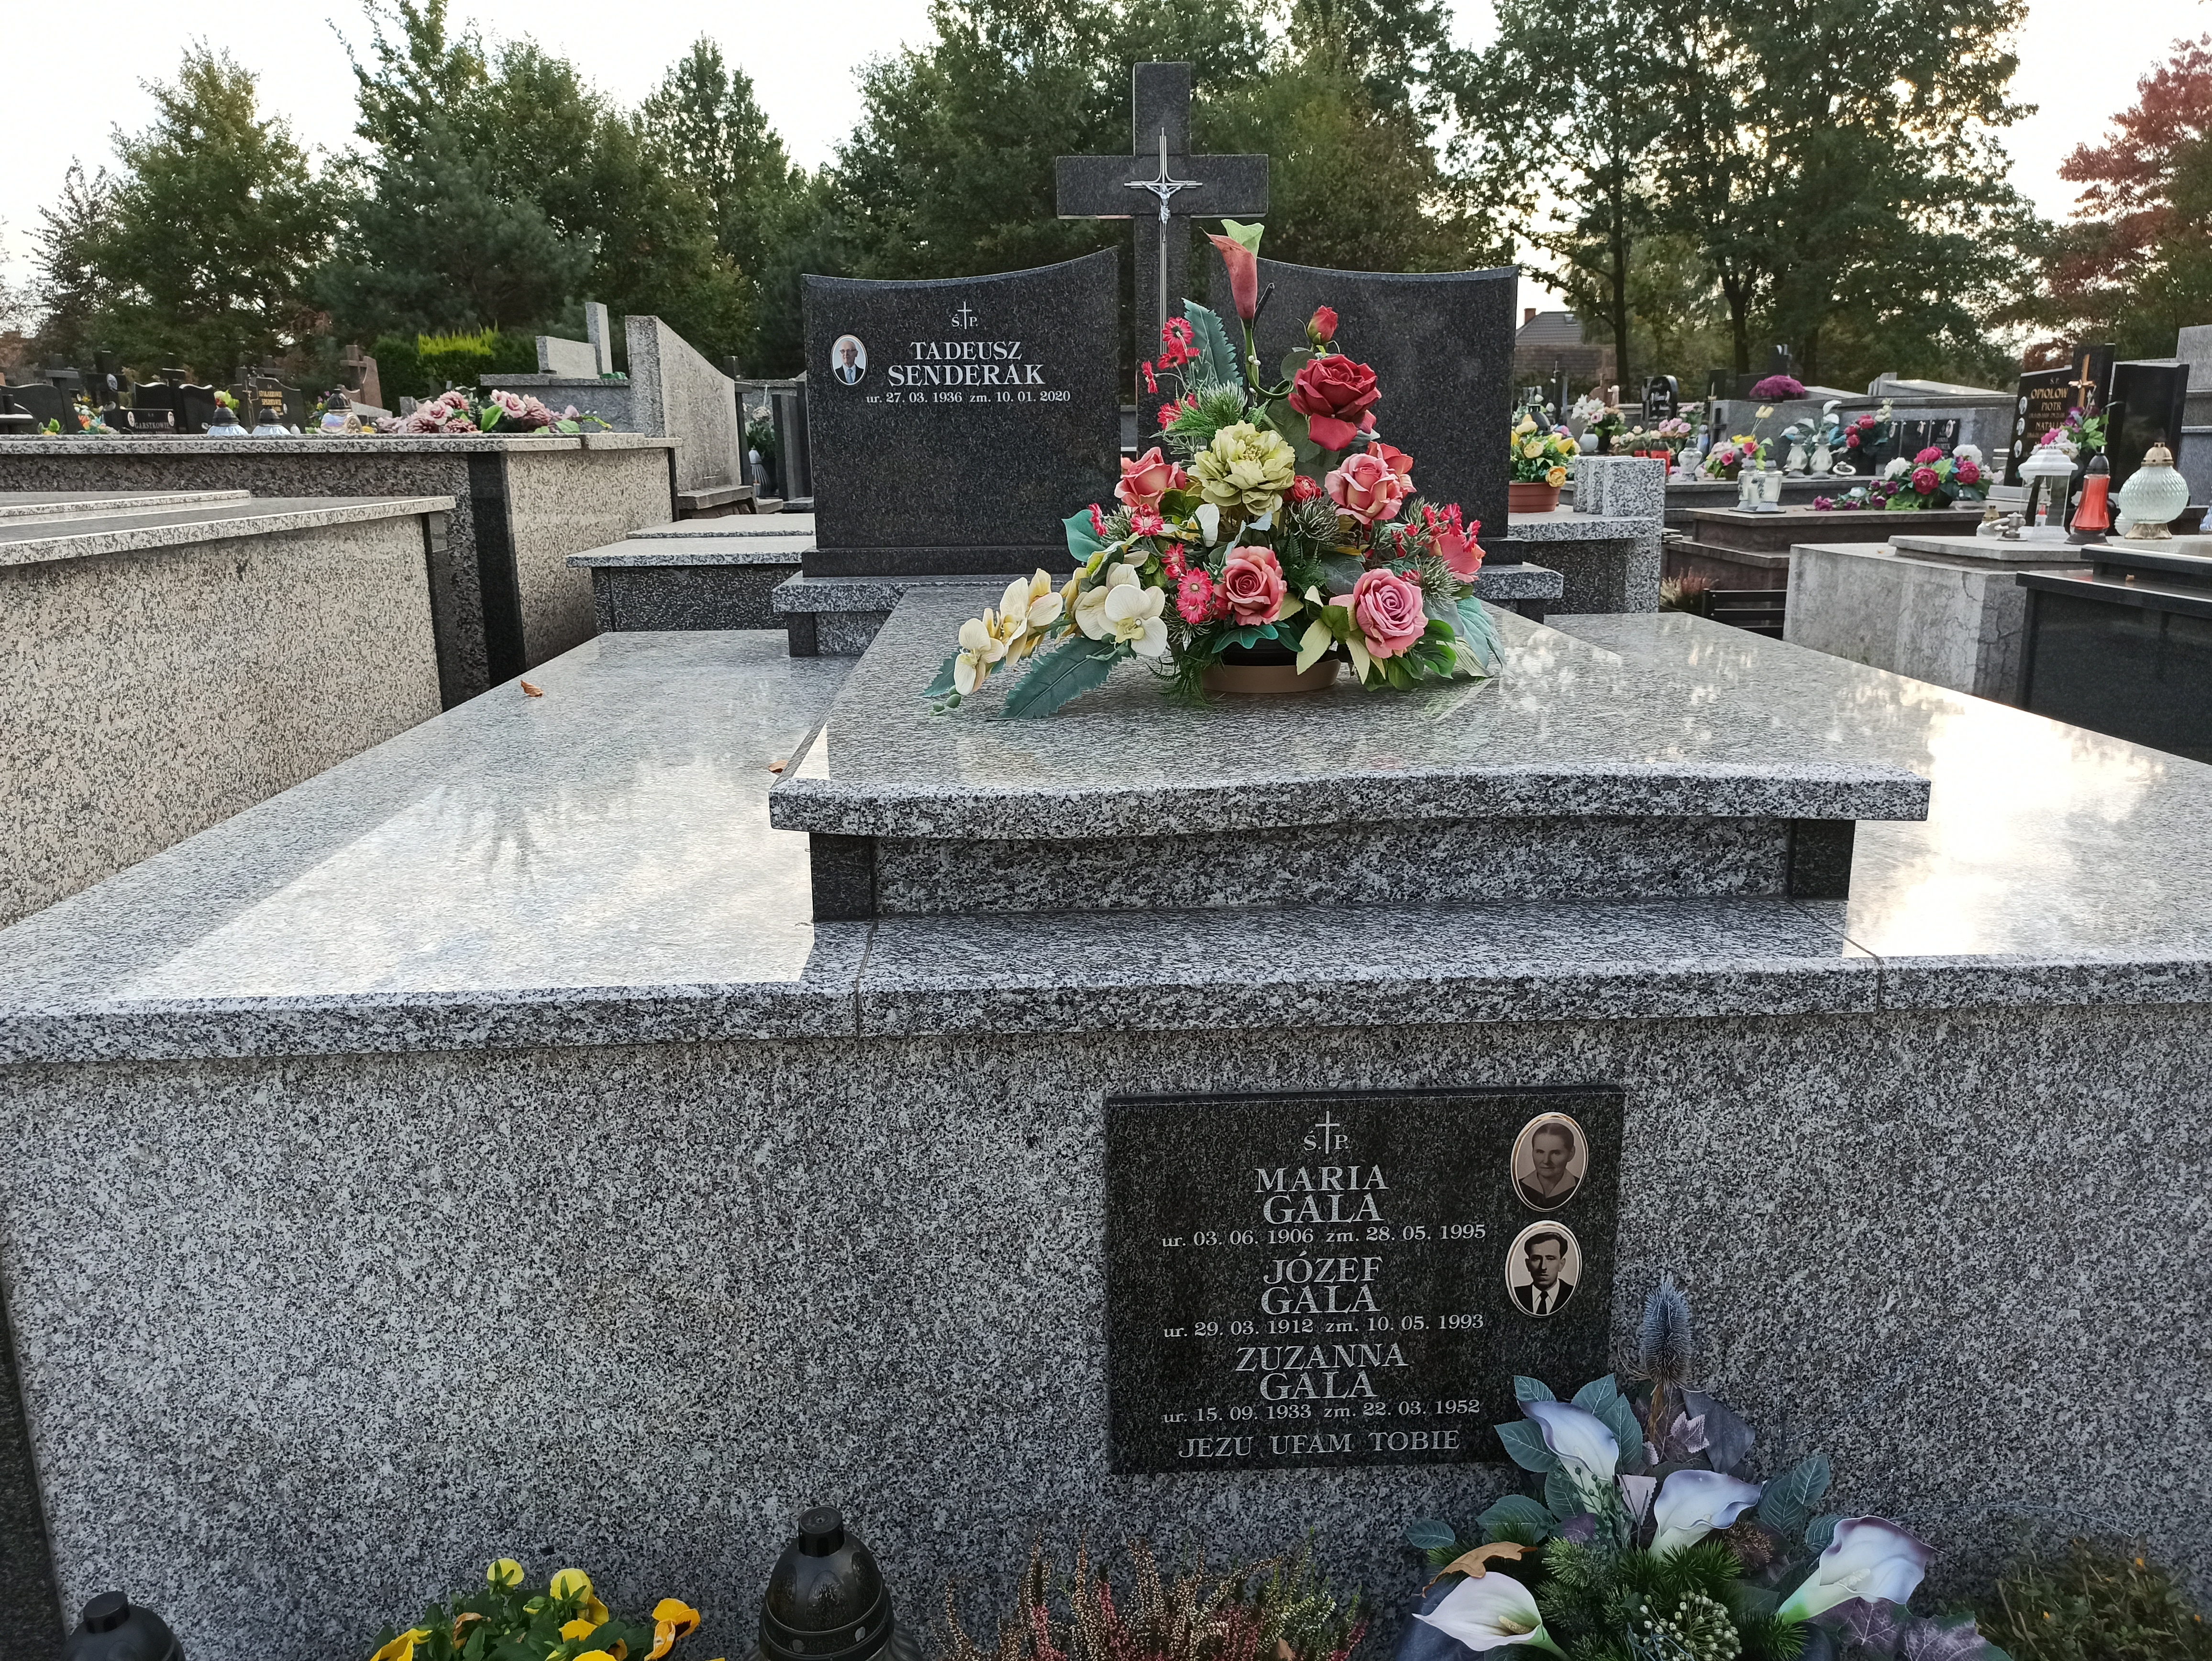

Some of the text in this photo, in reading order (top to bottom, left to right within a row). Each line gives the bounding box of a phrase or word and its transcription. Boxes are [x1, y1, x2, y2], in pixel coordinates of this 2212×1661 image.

[910, 341, 1022, 360] TADEUSZ
[888, 364, 1046, 387] SENDERAK
[886, 392, 905, 403] 27.
[909, 392, 928, 403] 03.
[932, 392, 962, 403] 1936
[996, 391, 1014, 402] 10.
[1018, 391, 1036, 402] 01.
[1040, 390, 1071, 401] 2020
[1254, 1164, 1390, 1193] MARIA
[1263, 1193, 1385, 1224] GALA
[1161, 1224, 1486, 1247] ur. 03. 06. 1906 zm. 28. 05. 1995
[1263, 1250, 1383, 1284] JÓZEF
[1261, 1284, 1382, 1315] GALA
[1163, 1314, 1483, 1338] ur. 29. 03. 1912 zm. 10. 05. 1993
[1235, 1342, 1409, 1372] ZUZANNA
[1260, 1370, 1379, 1401] GALA
[1163, 1399, 1480, 1423] ur. 15. 09. 1933 zm. 22. 03. 1952
[1179, 1430, 1460, 1458] JEZU UFAM TOBIE
